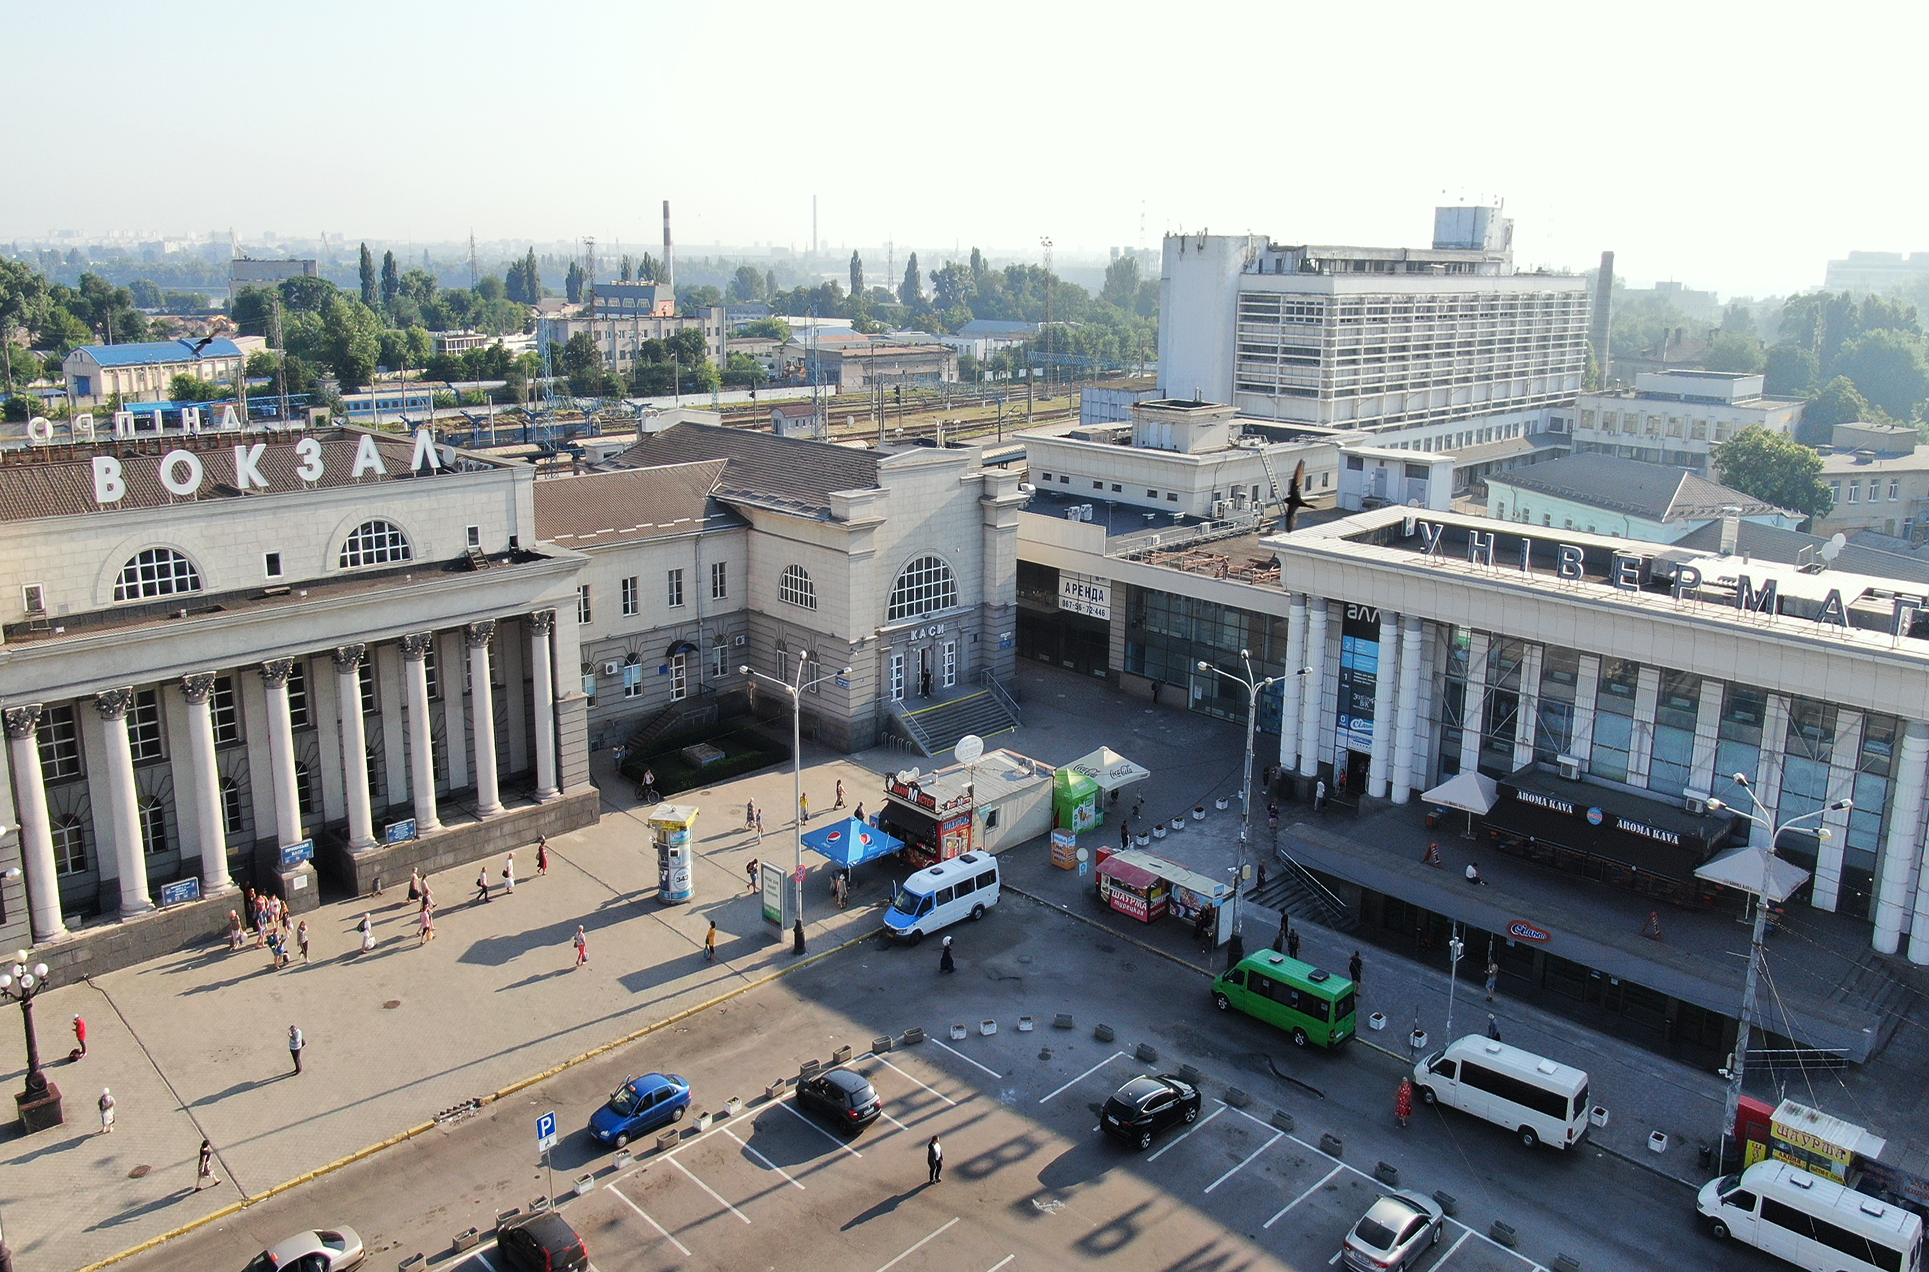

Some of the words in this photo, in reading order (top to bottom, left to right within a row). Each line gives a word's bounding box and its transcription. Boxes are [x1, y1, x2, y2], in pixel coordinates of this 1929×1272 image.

[93, 430, 441, 503] ВОКЗАЛ
[1419, 522, 1921, 636] УНІВЕРМАГ
[1065, 582, 1104, 602] АРЕНДА
[911, 624, 944, 640] КАСИ
[1516, 790, 1547, 807] AROMA
[1549, 800, 1573, 814] KAVA
[1616, 819, 1651, 837] AROMA
[1652, 829, 1679, 845] KAVA
[1111, 891, 1147, 911] ШАУРМА
[541, 1116, 552, 1137] P
[1777, 1124, 1846, 1160] ШАУРМА
